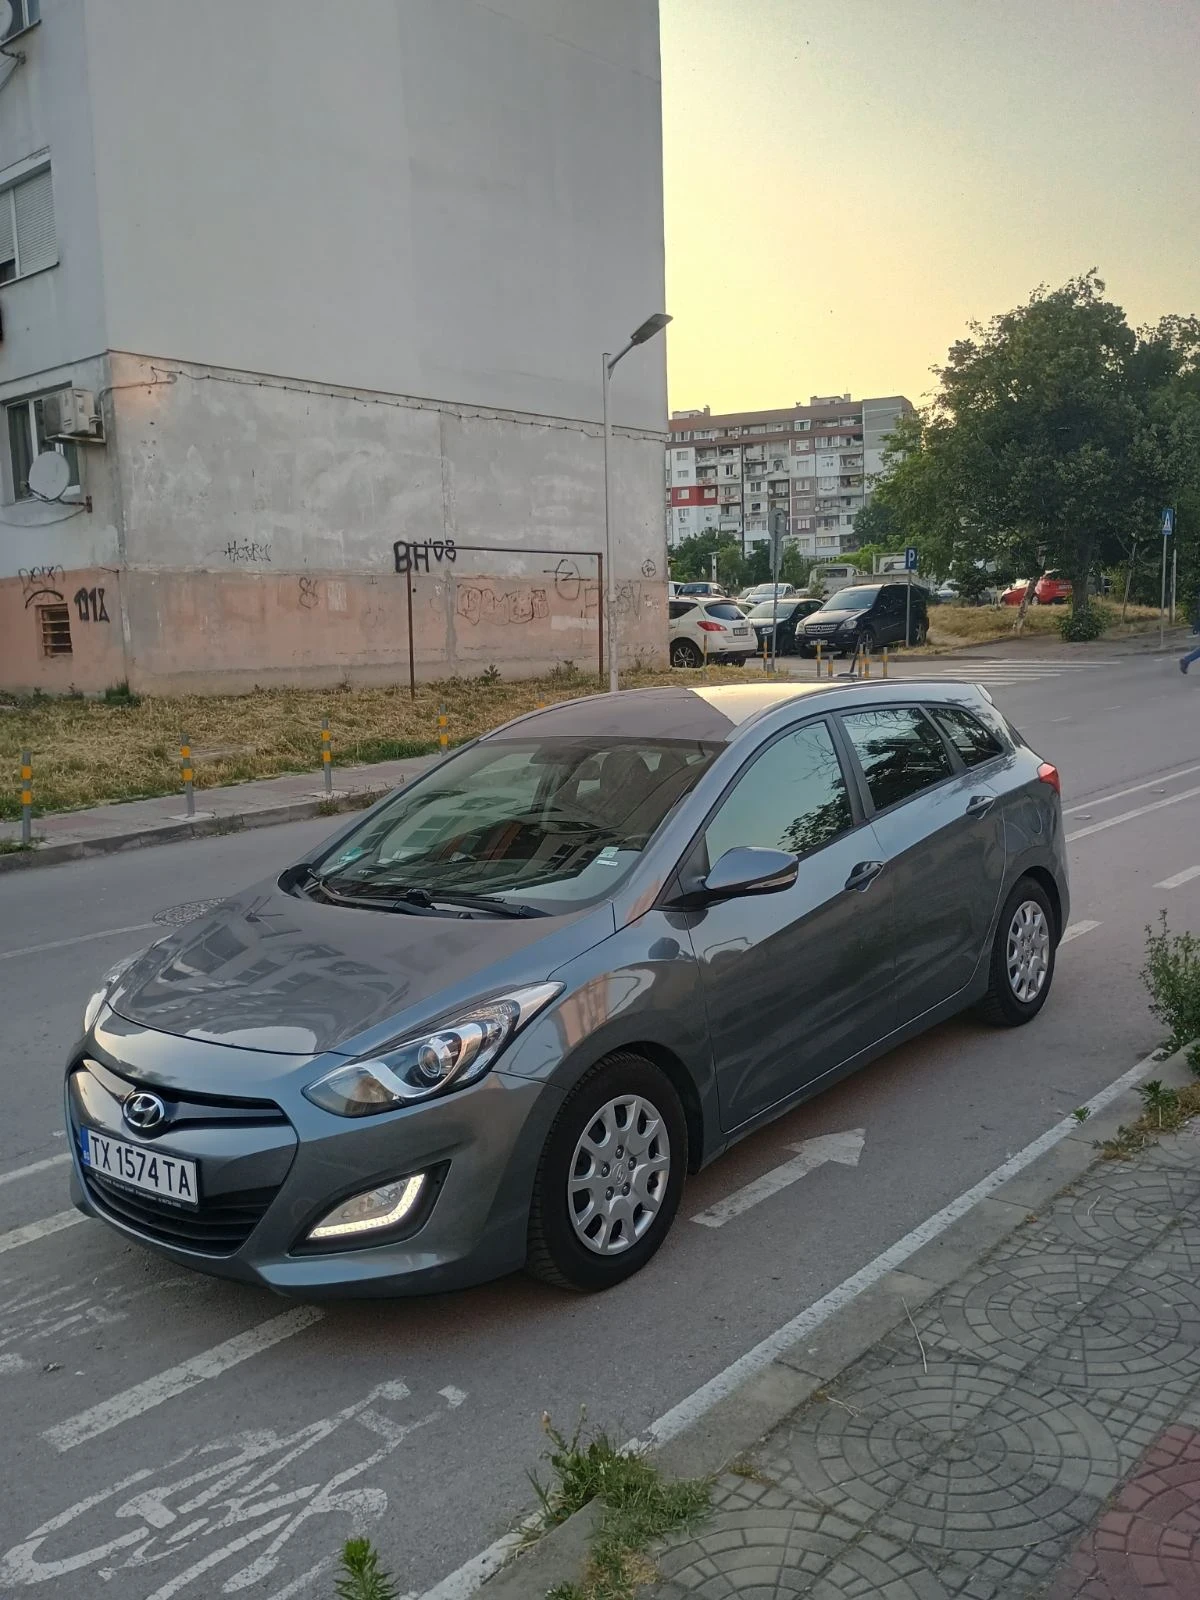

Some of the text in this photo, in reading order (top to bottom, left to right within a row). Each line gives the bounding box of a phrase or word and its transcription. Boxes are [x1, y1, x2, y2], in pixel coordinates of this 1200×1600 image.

[908, 549, 915, 567] P
[90, 1135, 111, 1172] TX
[116, 1145, 159, 1188] 1574
[163, 1160, 191, 1197] TA
